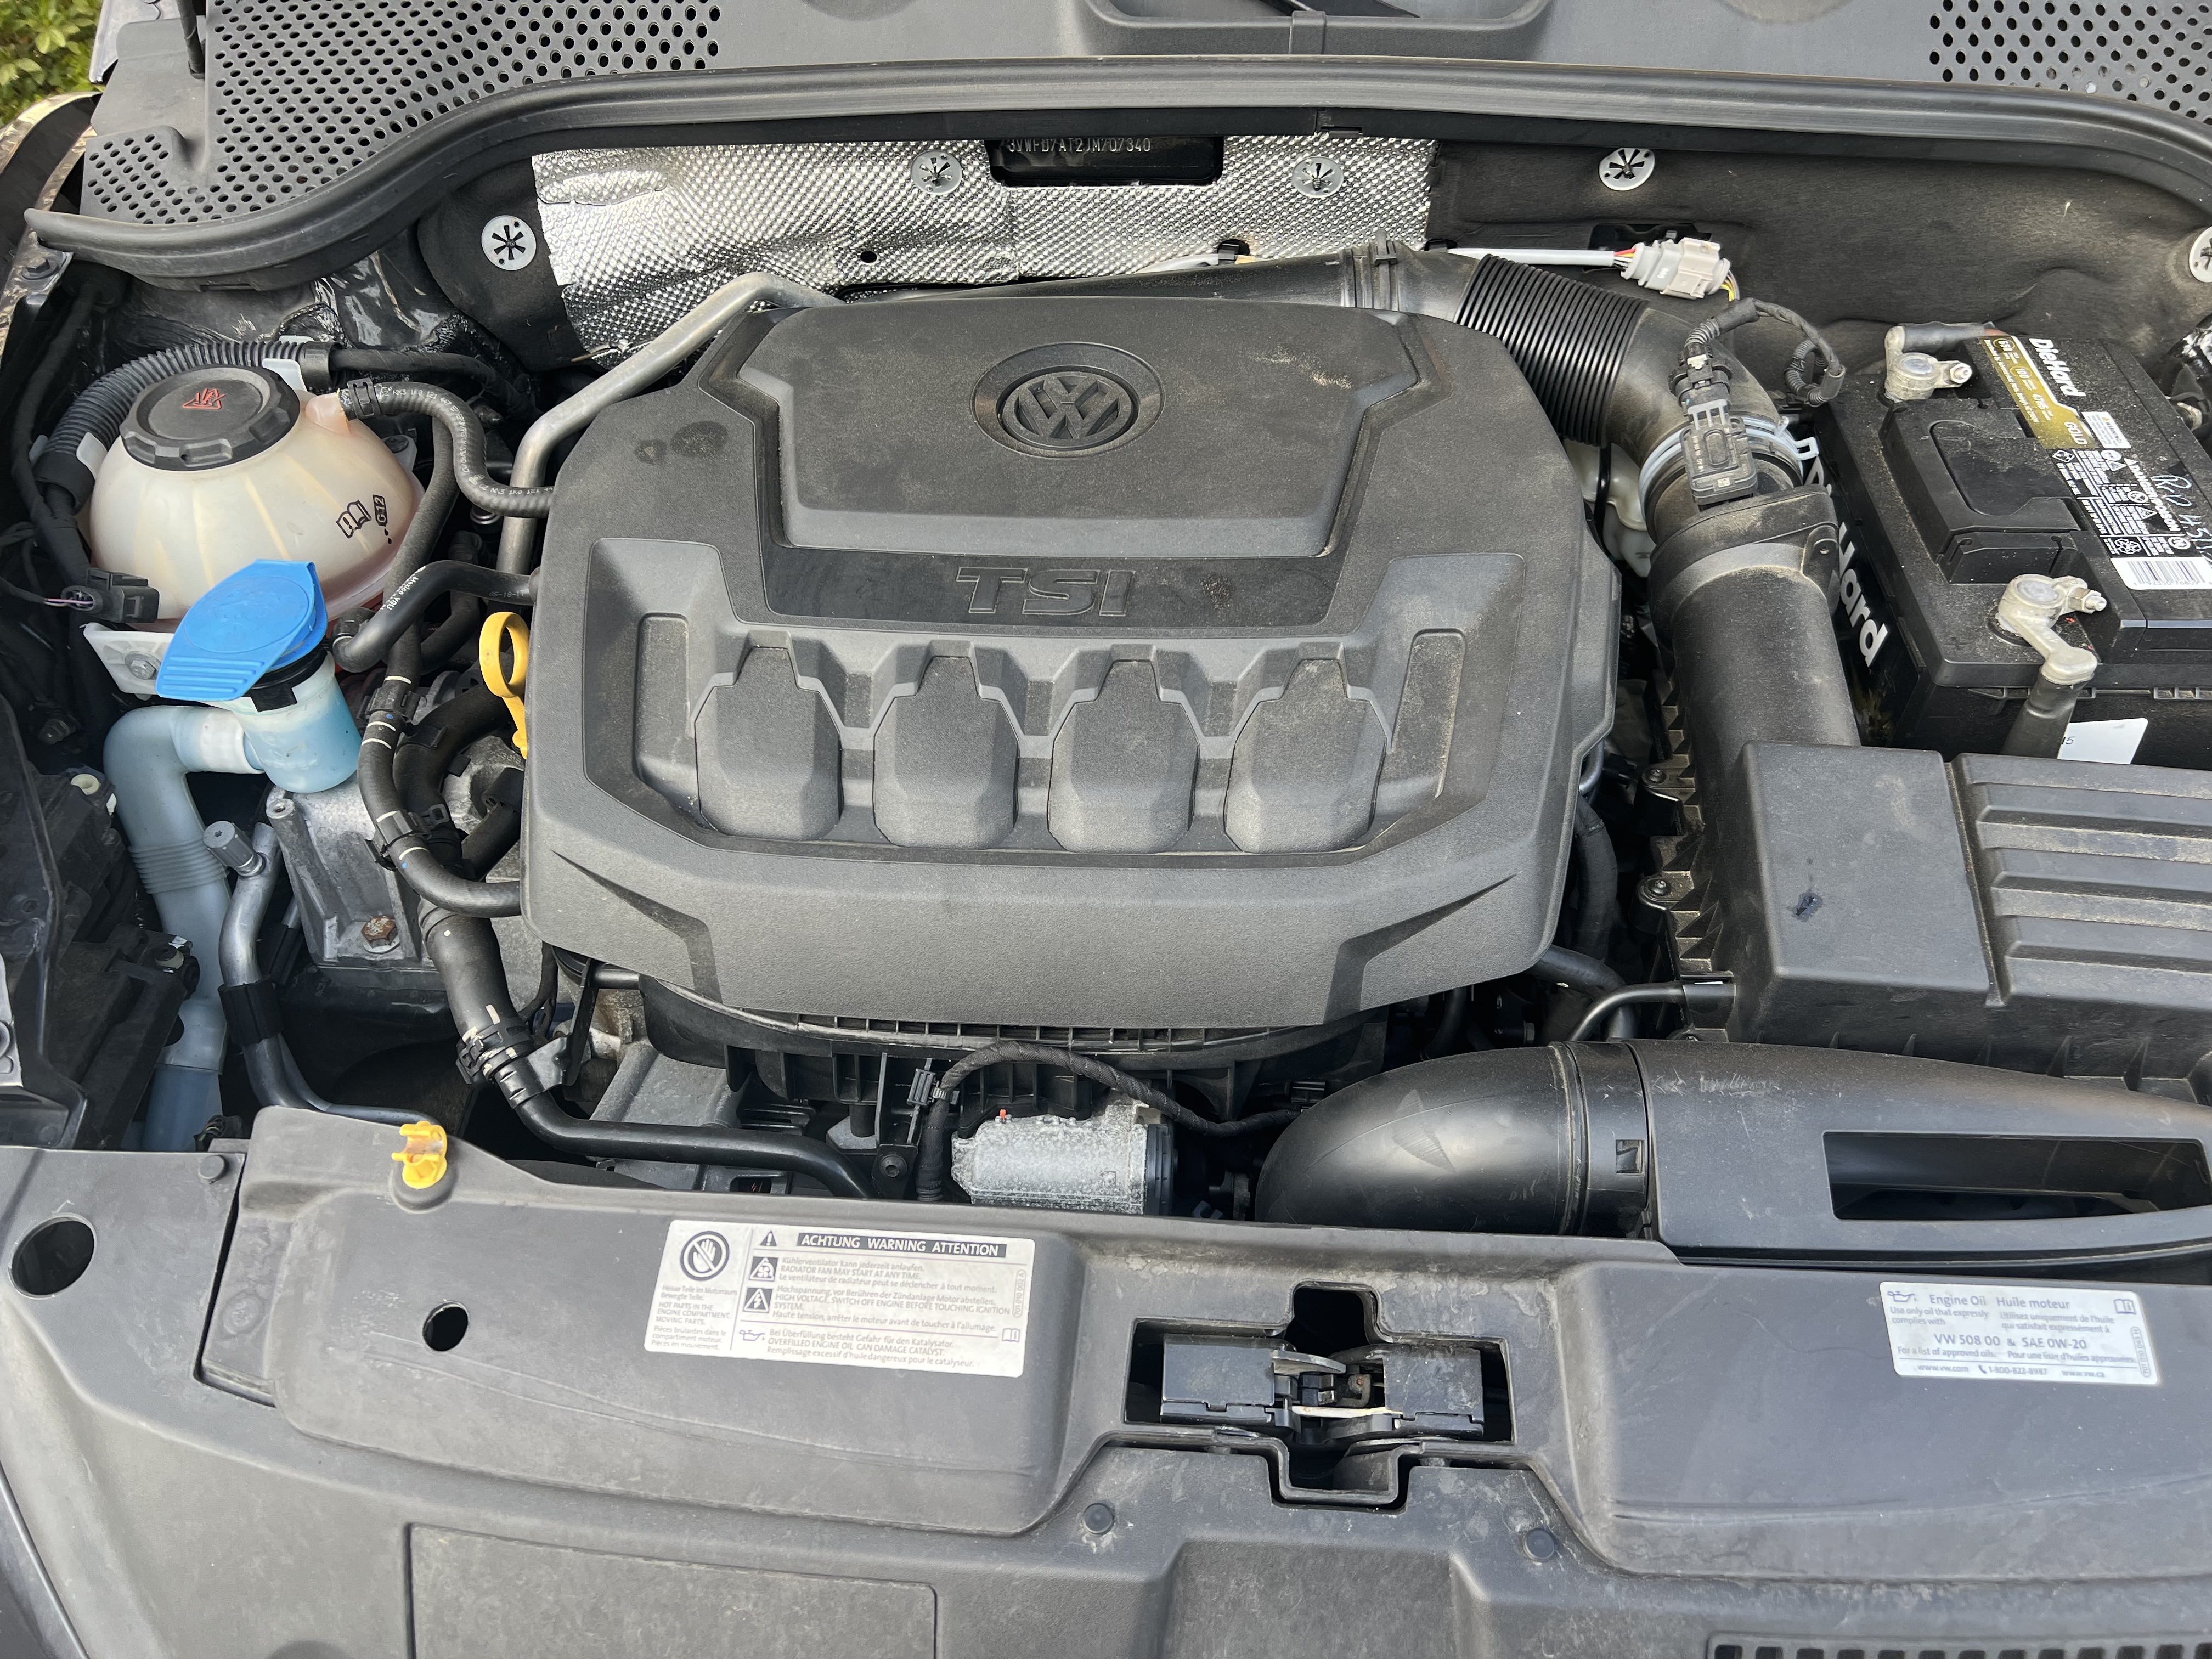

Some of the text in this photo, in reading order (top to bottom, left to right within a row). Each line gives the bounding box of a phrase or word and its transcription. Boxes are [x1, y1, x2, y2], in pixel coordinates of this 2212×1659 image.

[2015, 368, 2030, 379] 100
[2029, 338, 2086, 397] DieHard
[2064, 421, 2087, 445] GOLD
[2129, 465, 2181, 532] DANGER/POISON
[375, 496, 387, 523] G12
[956, 567, 1135, 616] TSI
[801, 1235, 998, 1256] ACHTUNG WARNING ATTENTION
[780, 1265, 816, 1273] RADIATOR
[859, 1262, 889, 1271] jederzeit
[788, 1274, 826, 1282] ventilateur
[838, 1277, 871, 1285] radiateur
[872, 1280, 889, 1288] peut
[893, 1293, 935, 1303] Zündanlage
[1929, 1294, 2070, 1308] Engine Oil Huile moteur
[831, 1297, 859, 1305] SWITCH
[877, 1300, 904, 1308] ENGINE
[905, 1301, 933, 1310] BEFORE
[934, 1303, 974, 1312] TOUCHING
[975, 1306, 1010, 1314] IGNITION
[772, 1310, 795, 1318] Haute
[826, 1314, 851, 1322] arrêter
[921, 1319, 949, 1328] toucher
[1905, 1307, 1922, 1316] only
[1953, 1309, 1989, 1319] expressly
[1891, 1316, 1927, 1325] complies
[782, 1329, 826, 1341] Überfüllung
[827, 1333, 854, 1341] besteht
[855, 1334, 881, 1343] Gefahr
[1933, 1334, 2087, 1349] VW 508 00 & SAE 0W-20
[766, 1346, 811, 1357] Remplissage
[812, 1349, 842, 1358] excessif
[768, 1337, 810, 1346] OVERFILLED
[812, 1340, 839, 1348] ENGINE
[873, 1344, 907, 1353] DAMAGE
